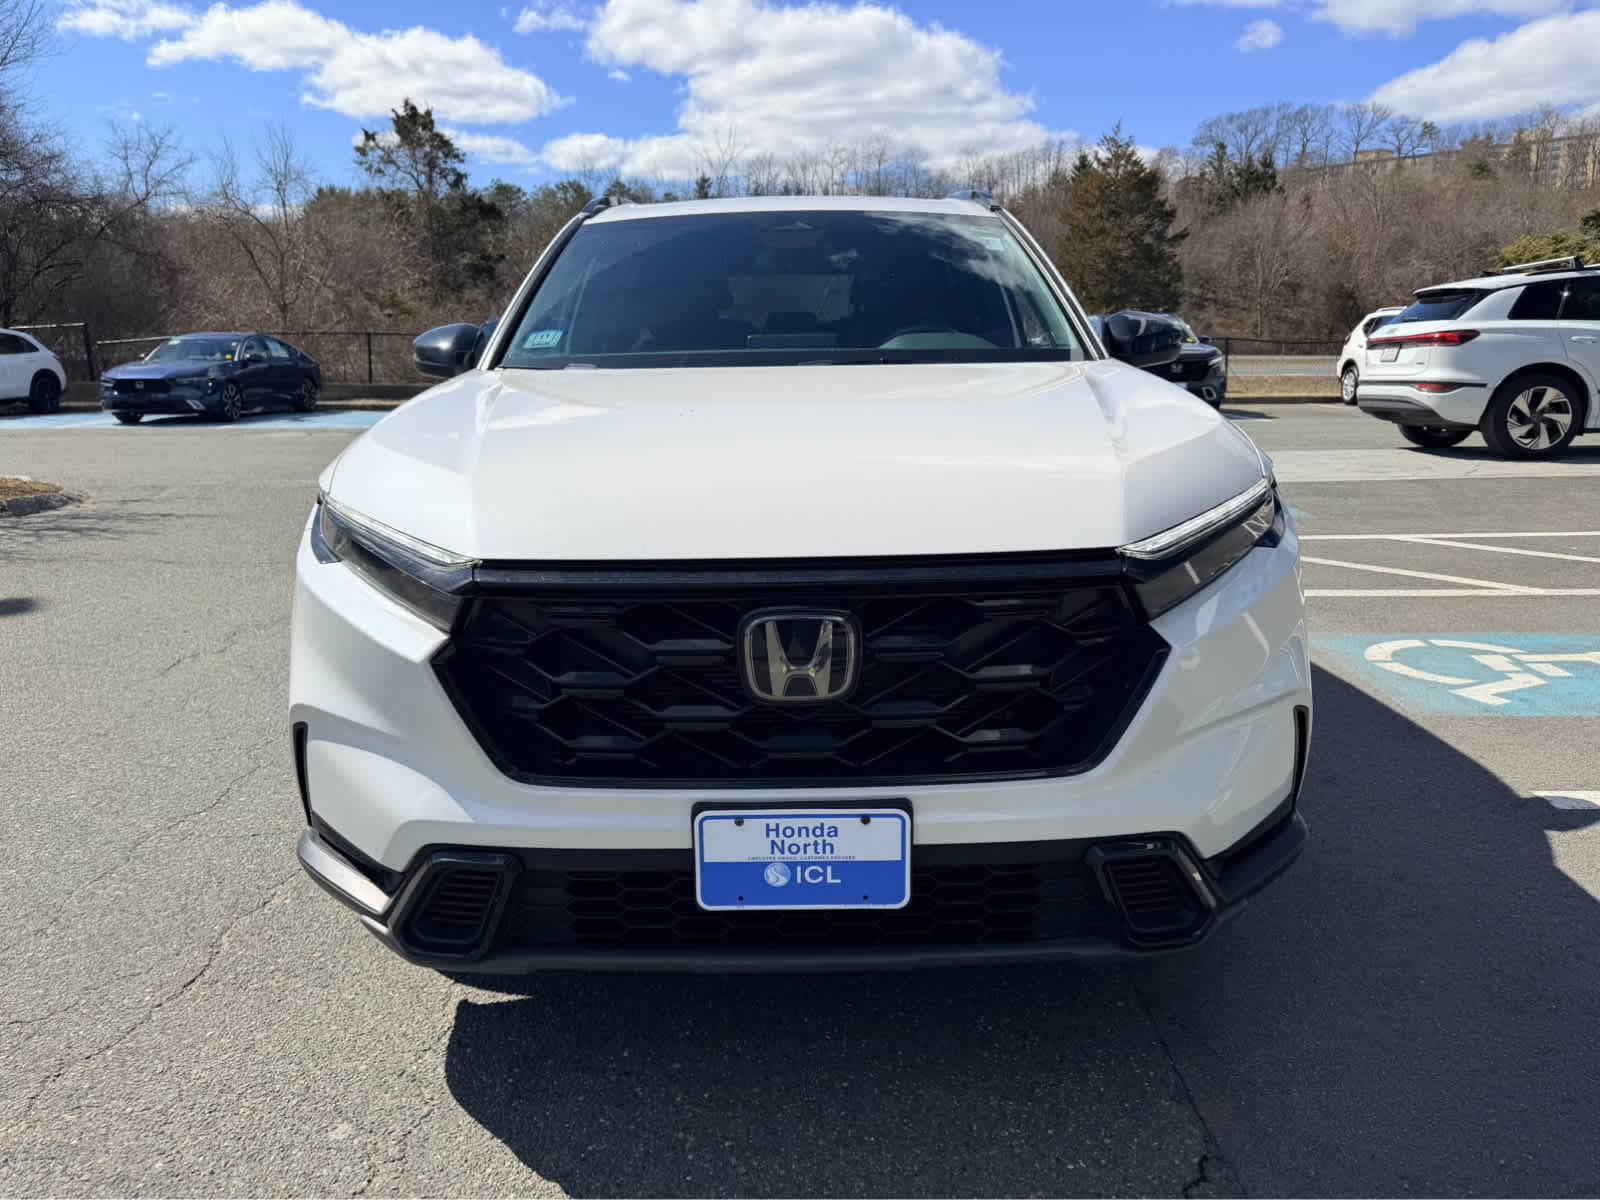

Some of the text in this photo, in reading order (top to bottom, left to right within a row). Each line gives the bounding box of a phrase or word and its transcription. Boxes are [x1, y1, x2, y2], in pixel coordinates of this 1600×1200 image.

[765, 822, 839, 839] Honda
[770, 839, 835, 855] North
[796, 864, 842, 884] ICL
